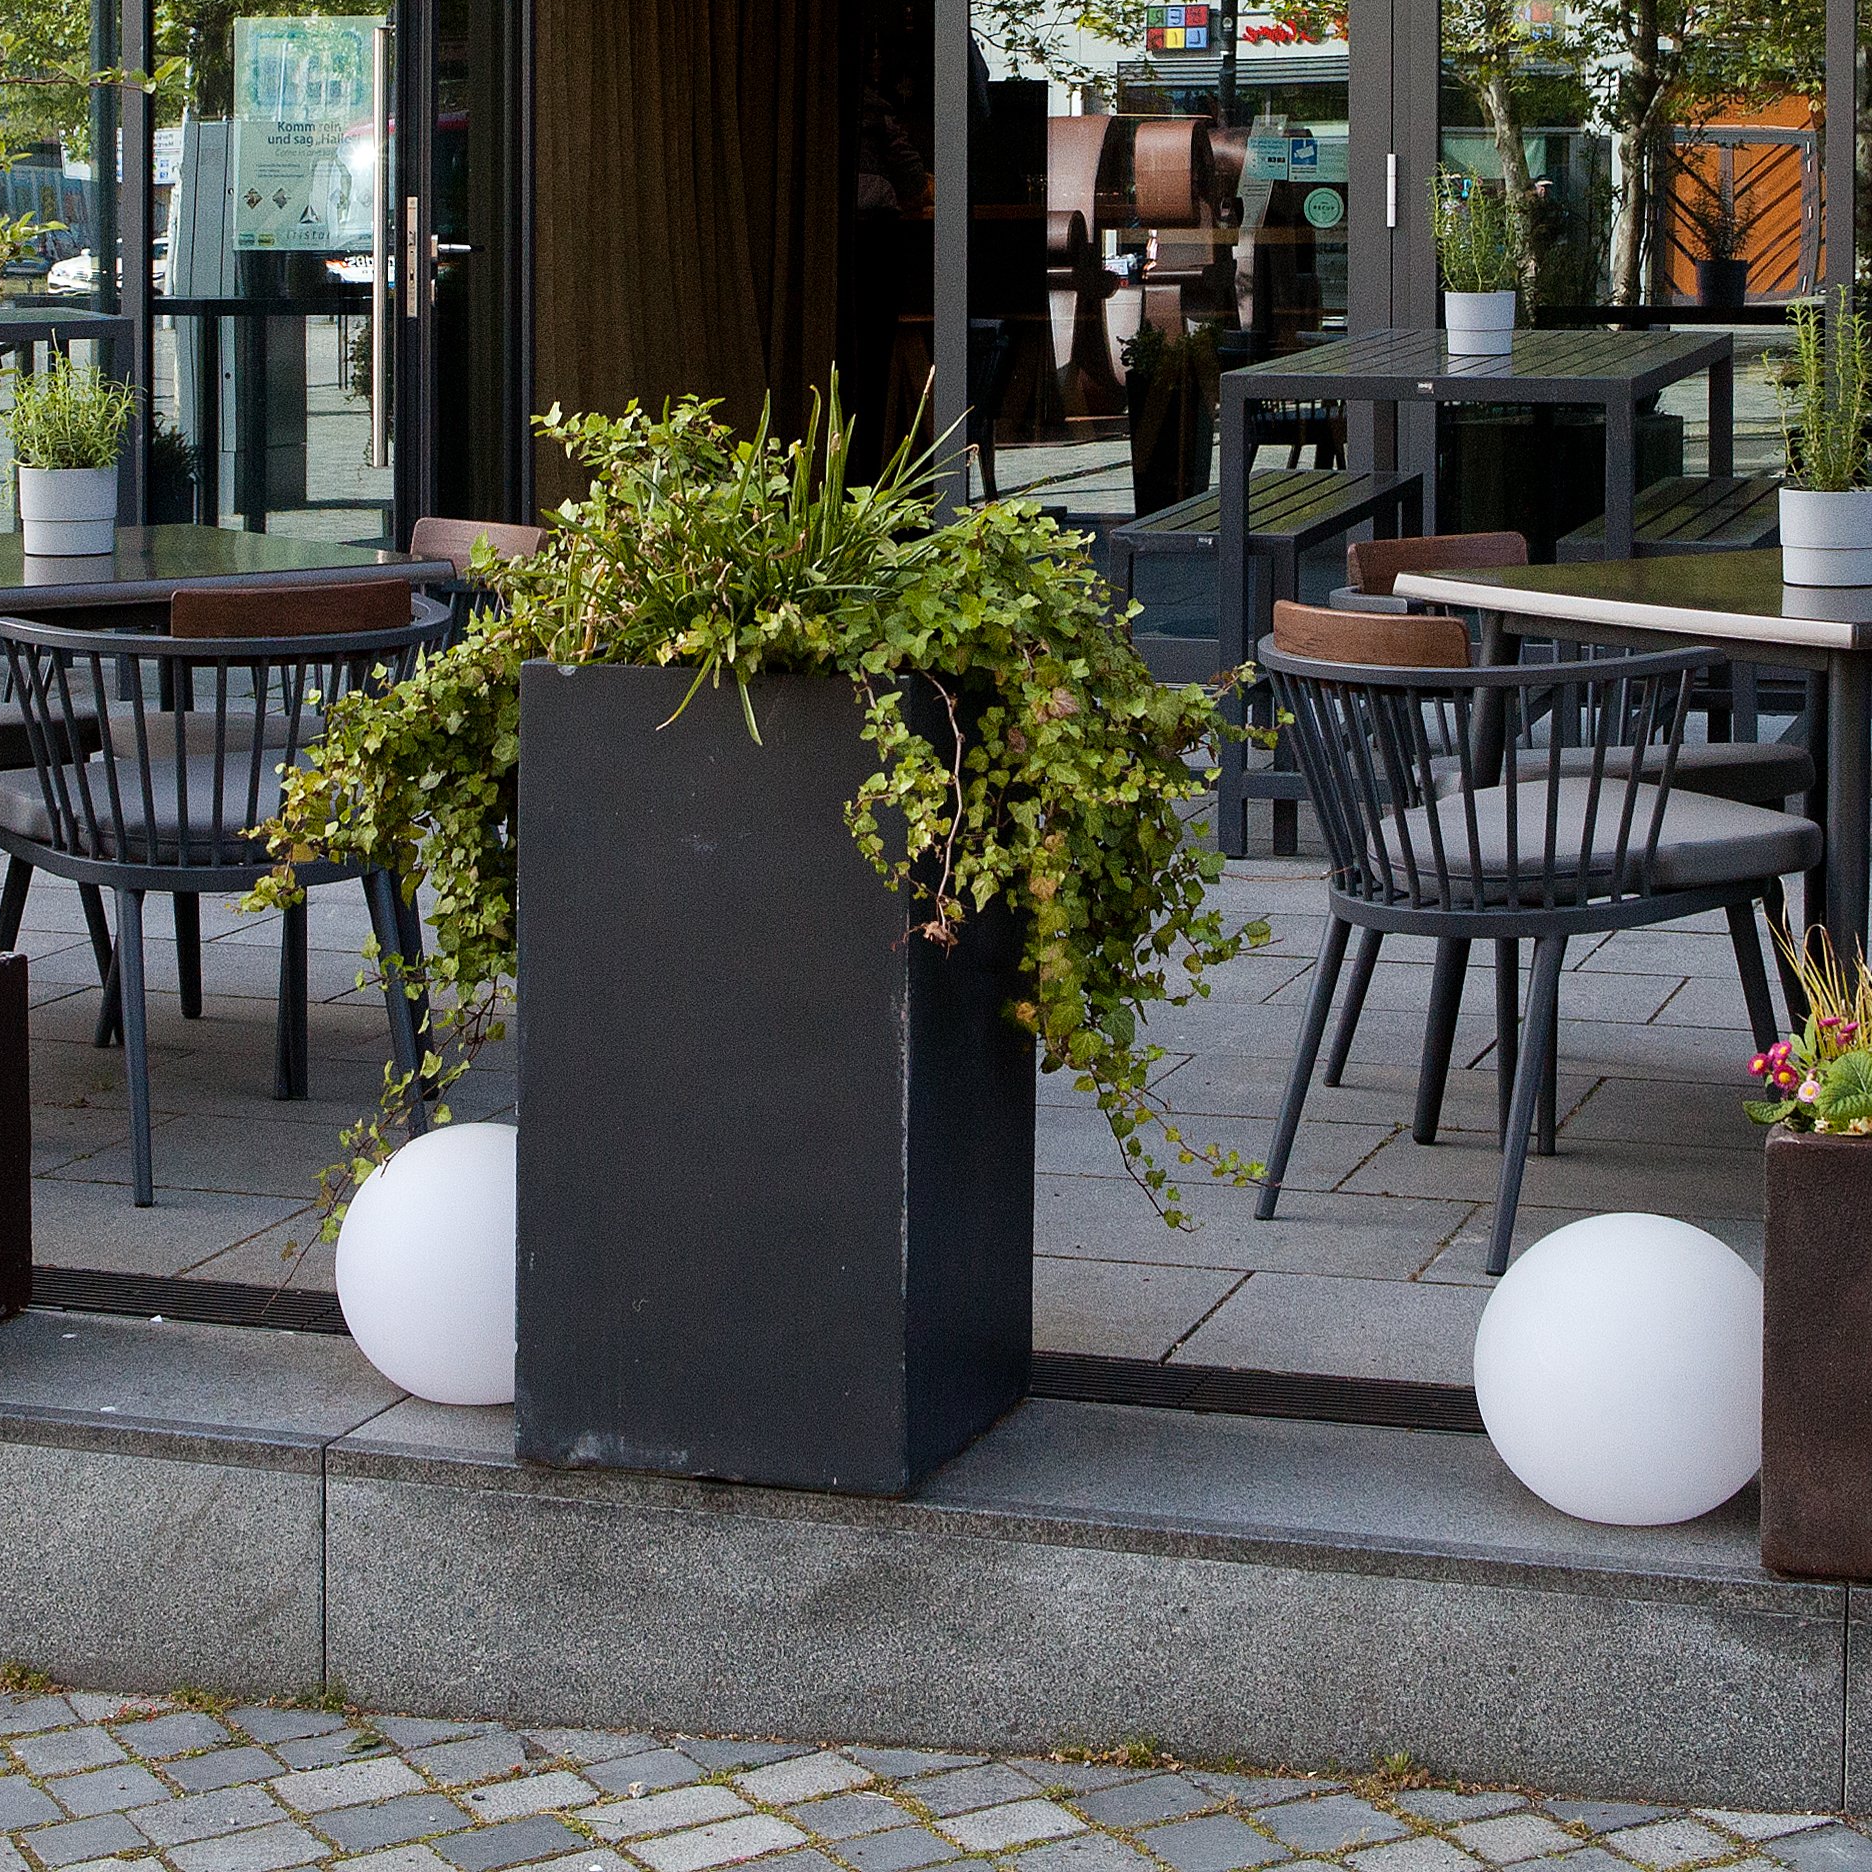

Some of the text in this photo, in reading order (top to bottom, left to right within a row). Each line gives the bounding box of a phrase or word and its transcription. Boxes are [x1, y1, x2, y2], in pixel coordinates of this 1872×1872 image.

[277, 121, 316, 133] Komm
[267, 133, 292, 145] und
[294, 135, 314, 148] sag
